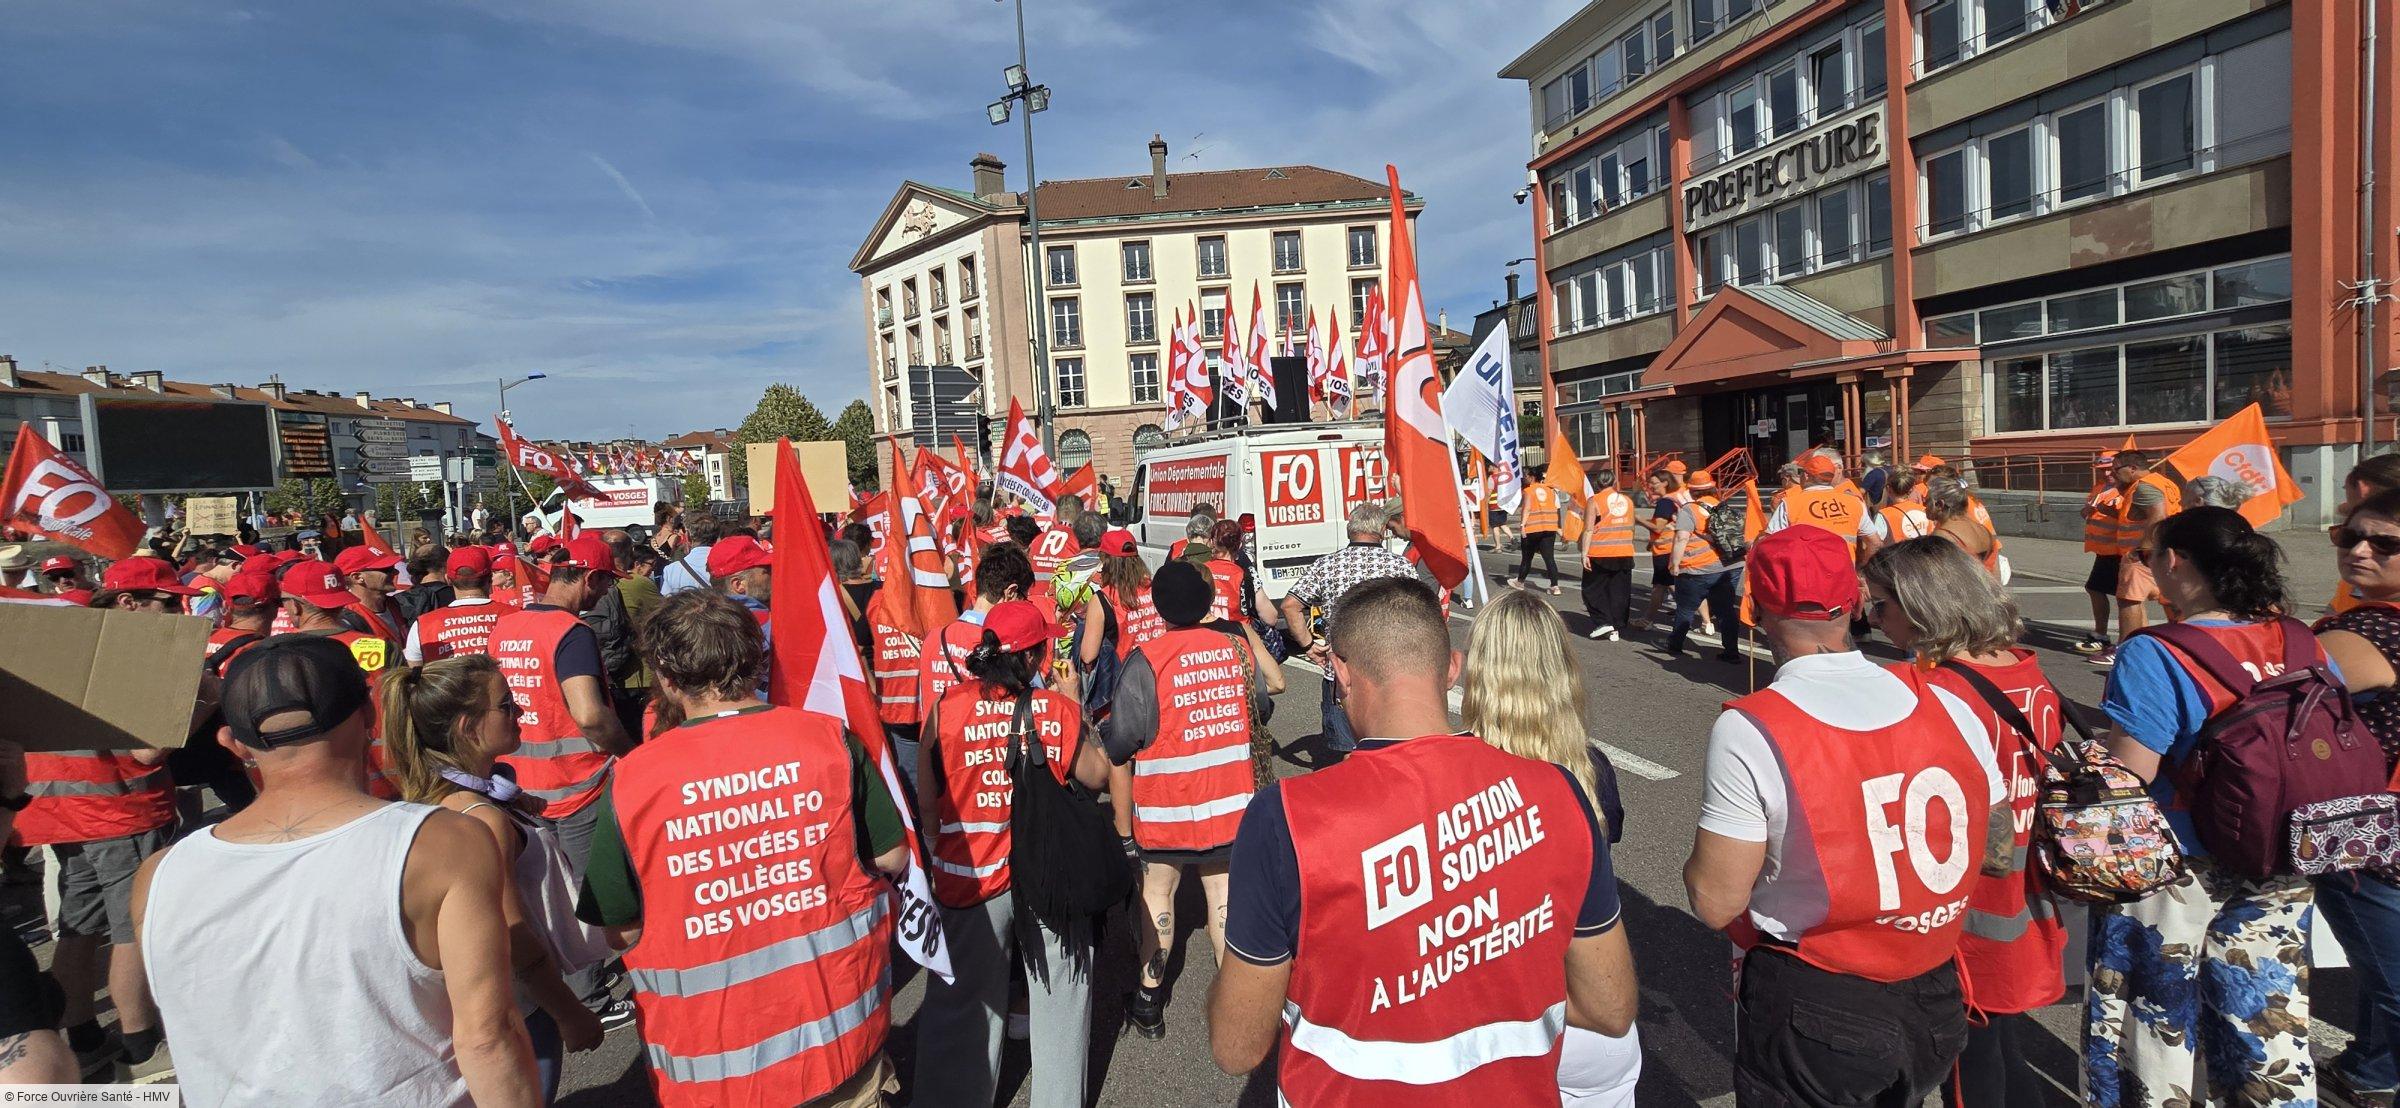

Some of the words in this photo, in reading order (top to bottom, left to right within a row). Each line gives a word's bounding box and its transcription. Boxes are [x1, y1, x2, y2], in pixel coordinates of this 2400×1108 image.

[1684, 112, 1881, 222] PREFECTURE
[520, 448, 552, 470] FO
[1150, 468, 1167, 482] Union
[1168, 461, 1224, 484] Départementale
[1270, 454, 1314, 504] FO
[14, 458, 112, 531] FO
[614, 492, 646, 501] VOSGES
[1150, 492, 1166, 512] FORCE
[1268, 503, 1320, 524] VOSGES
[1040, 530, 1068, 555] FO
[444, 614, 498, 627] SYNDICAT
[438, 626, 490, 641] NATIONAL
[458, 637, 488, 650] LYCÉE
[358, 651, 382, 668] FO
[524, 658, 540, 670] FO
[882, 648, 899, 660] DES
[1180, 648, 1234, 668] SYNDICAT
[1173, 667, 1232, 688] NATIONAL
[1174, 692, 1198, 708] DES
[1200, 684, 1235, 702] LYCÉES
[1237, 684, 1244, 696] E
[976, 699, 1048, 716] SYNDAT
[1041, 720, 1061, 736] FO
[1184, 726, 1206, 742] DES
[965, 748, 993, 766] DES
[682, 762, 800, 804] SYNDICAT
[976, 792, 1002, 808] DES
[665, 798, 788, 842] NATIONAL
[792, 790, 822, 815] FO
[1437, 776, 1524, 852] ACTION
[667, 850, 713, 877] DES
[718, 829, 800, 868] LYCÉES
[804, 822, 829, 847] ET
[1441, 804, 1545, 892] SOCIALE
[1862, 766, 1970, 911] FO
[694, 859, 813, 906] COLLÈGES
[1374, 845, 1421, 910] FO
[684, 910, 734, 940] DES
[736, 884, 828, 926] VOSGES
[1418, 888, 1499, 956] NON
[1370, 978, 1392, 1014] À
[1398, 894, 1554, 1004] L'AUSTÉRITÉ
